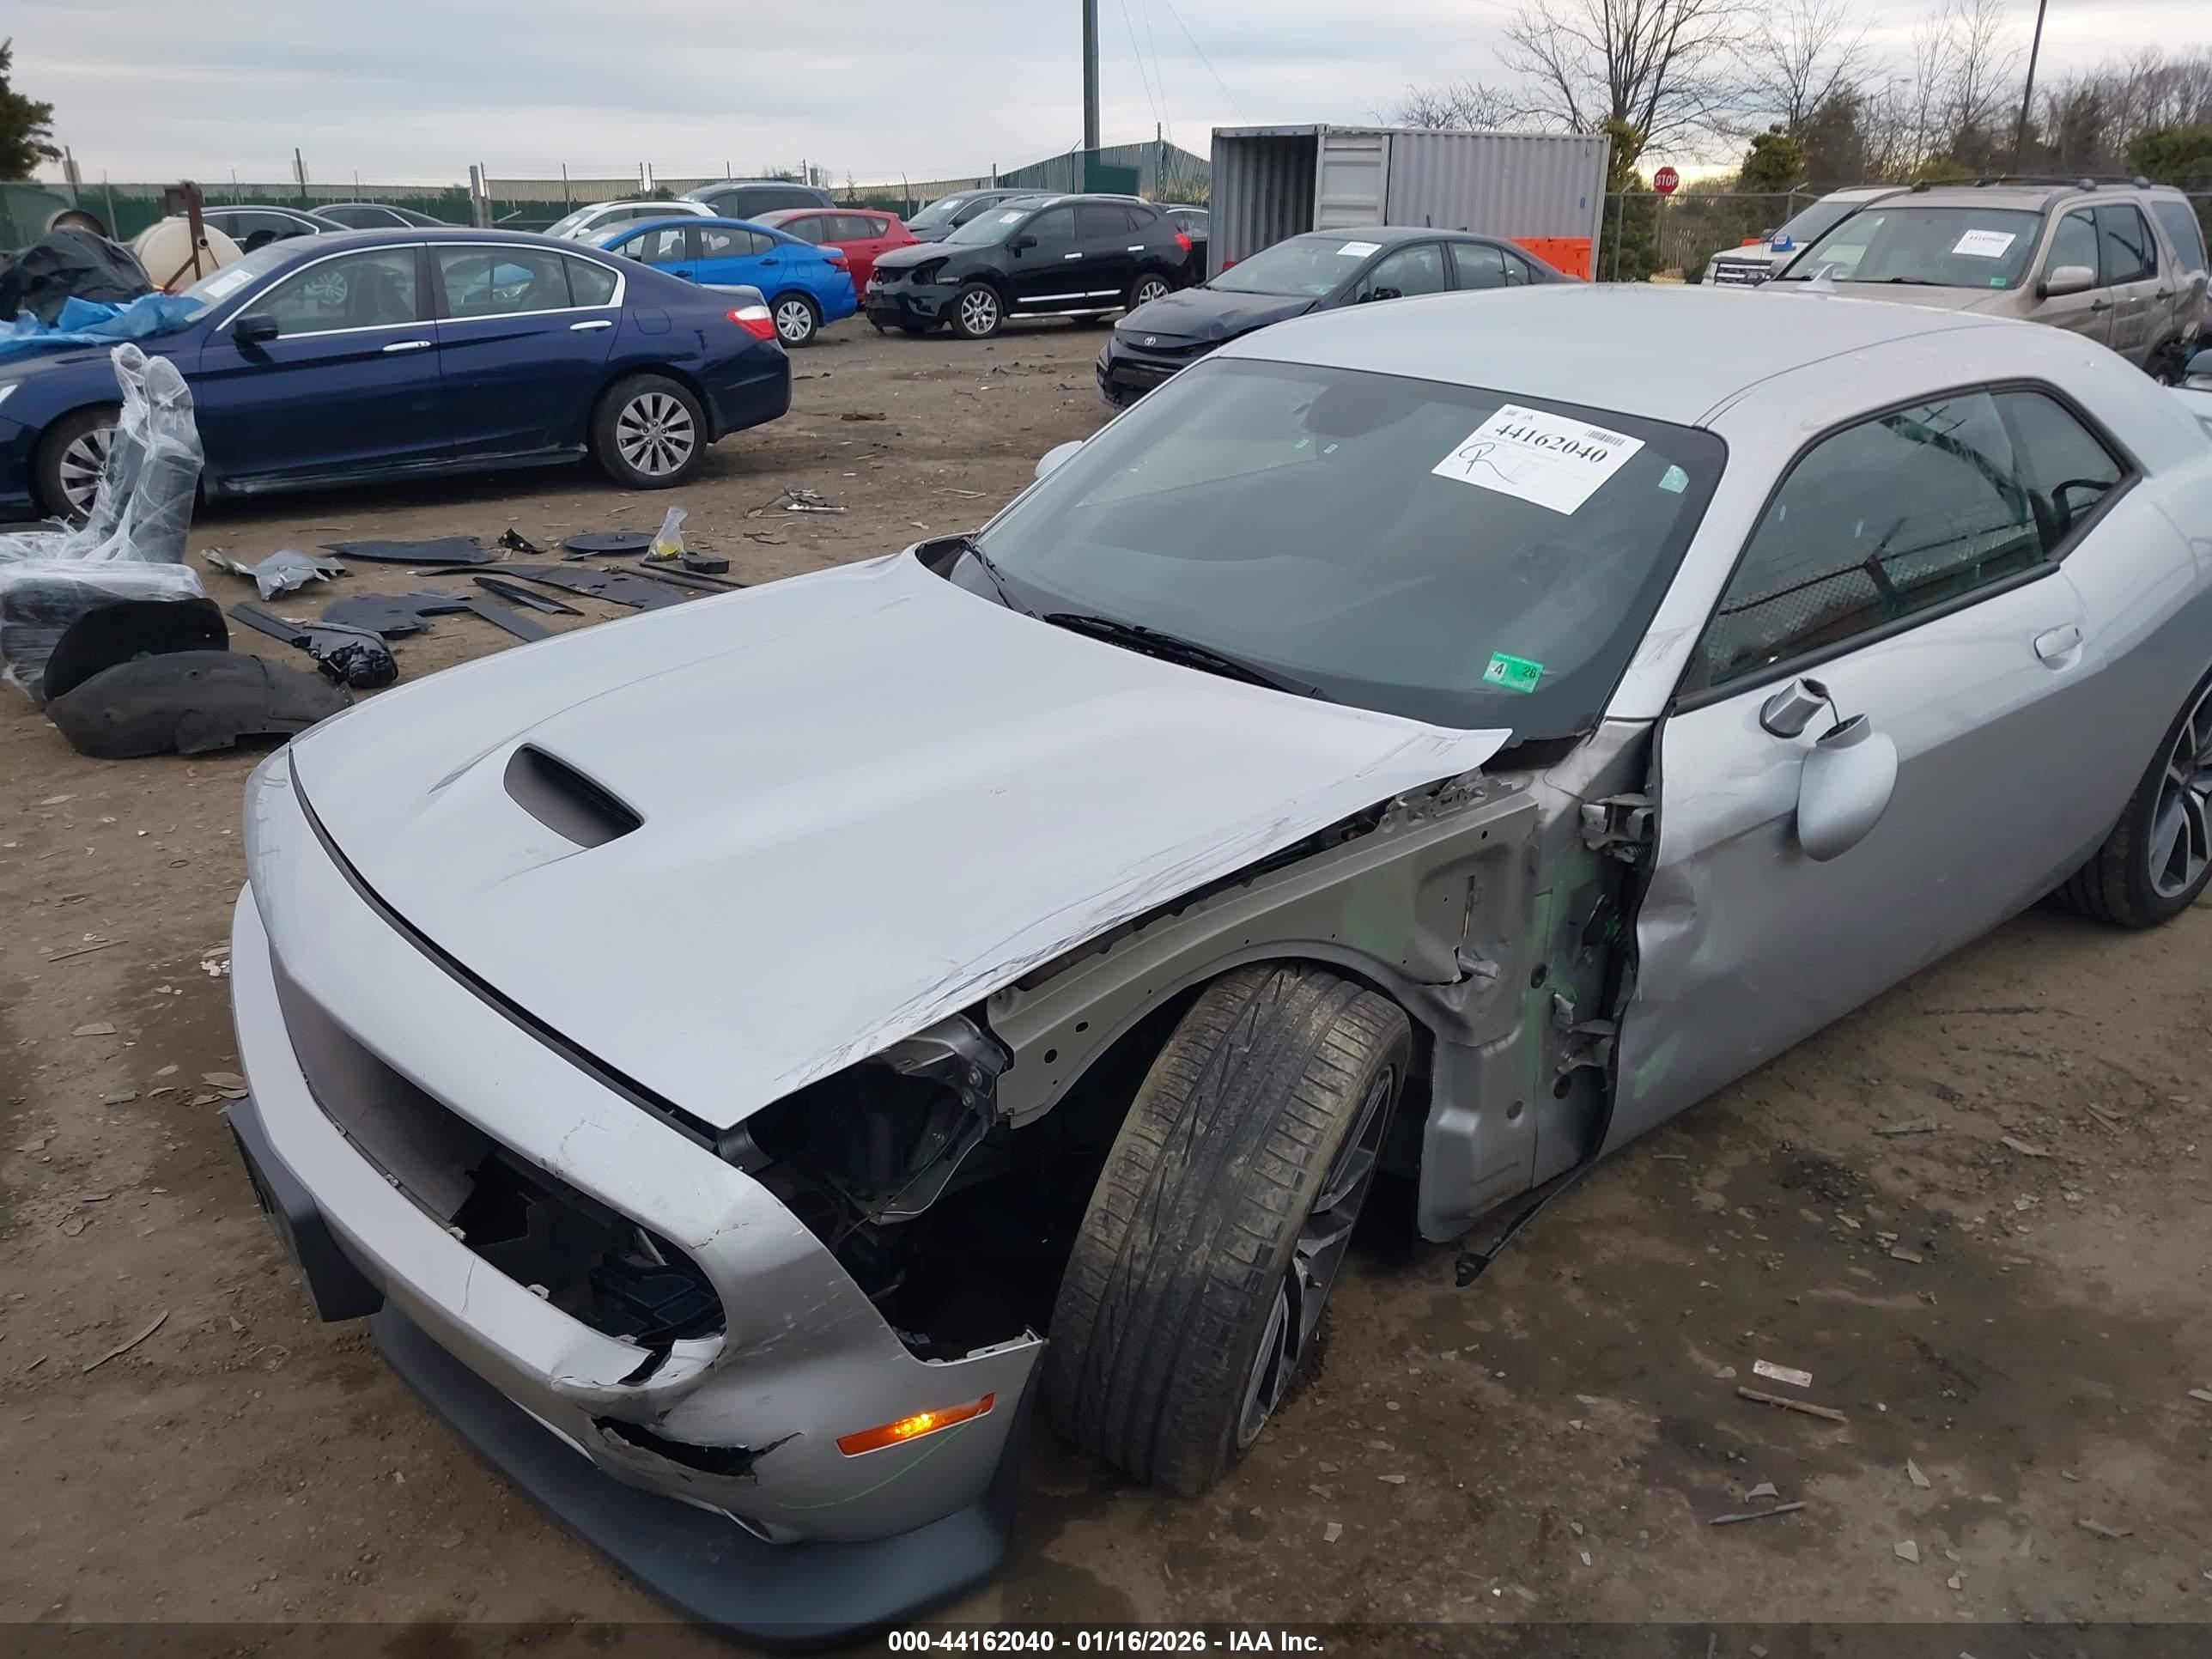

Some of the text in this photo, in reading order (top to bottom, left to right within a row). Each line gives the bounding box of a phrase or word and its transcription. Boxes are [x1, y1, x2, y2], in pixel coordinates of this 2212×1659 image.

[1656, 174, 1678, 186] STOP
[1495, 423, 1608, 464] 44162040
[1494, 663, 1504, 676] 4
